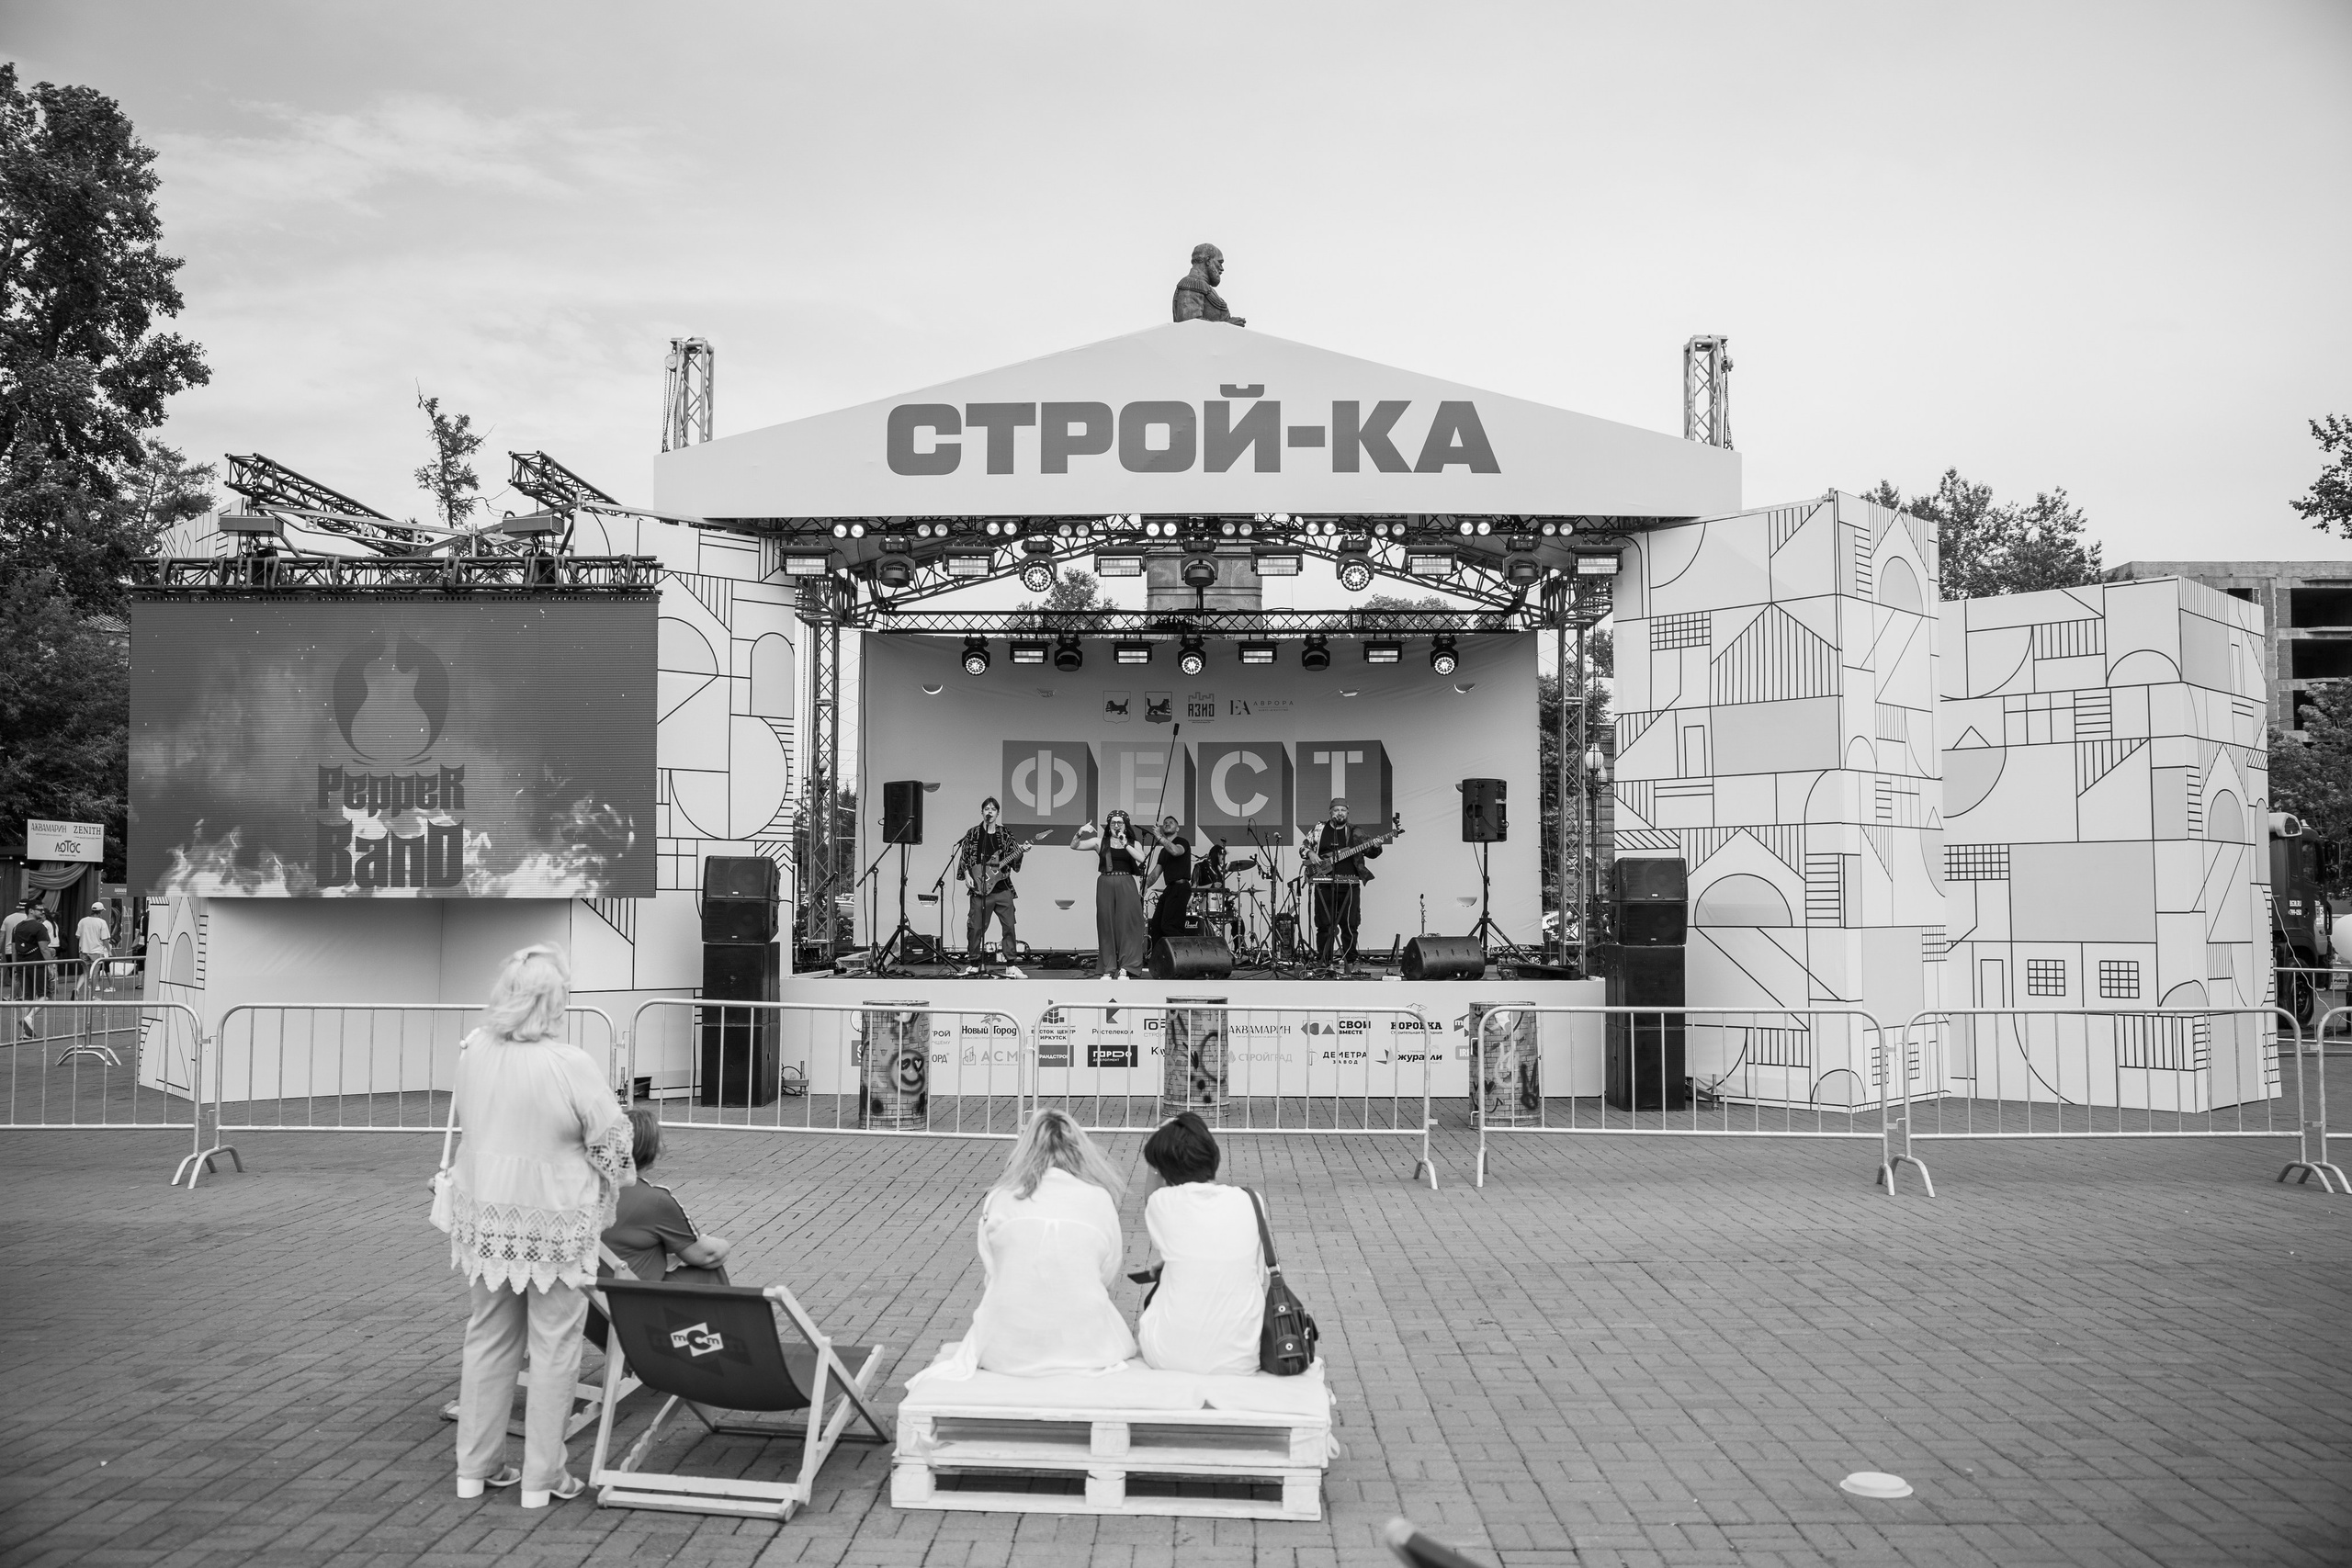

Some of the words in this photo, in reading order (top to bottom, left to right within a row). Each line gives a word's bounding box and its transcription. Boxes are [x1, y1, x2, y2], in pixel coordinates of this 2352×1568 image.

[887, 384, 1502, 476] СТРОЙ-КА
[1012, 750, 1363, 818] ФЕСТ
[74, 825, 102, 835] ZENITH
[962, 1025, 989, 1034] Новый
[993, 1025, 1017, 1036] Город
[1228, 1025, 1291, 1034] АКВАМАРИН
[980, 1050, 1018, 1062] АСМ
[1238, 1052, 1293, 1063] СТРОЙГРАД
[1397, 1054, 1443, 1062] журали
